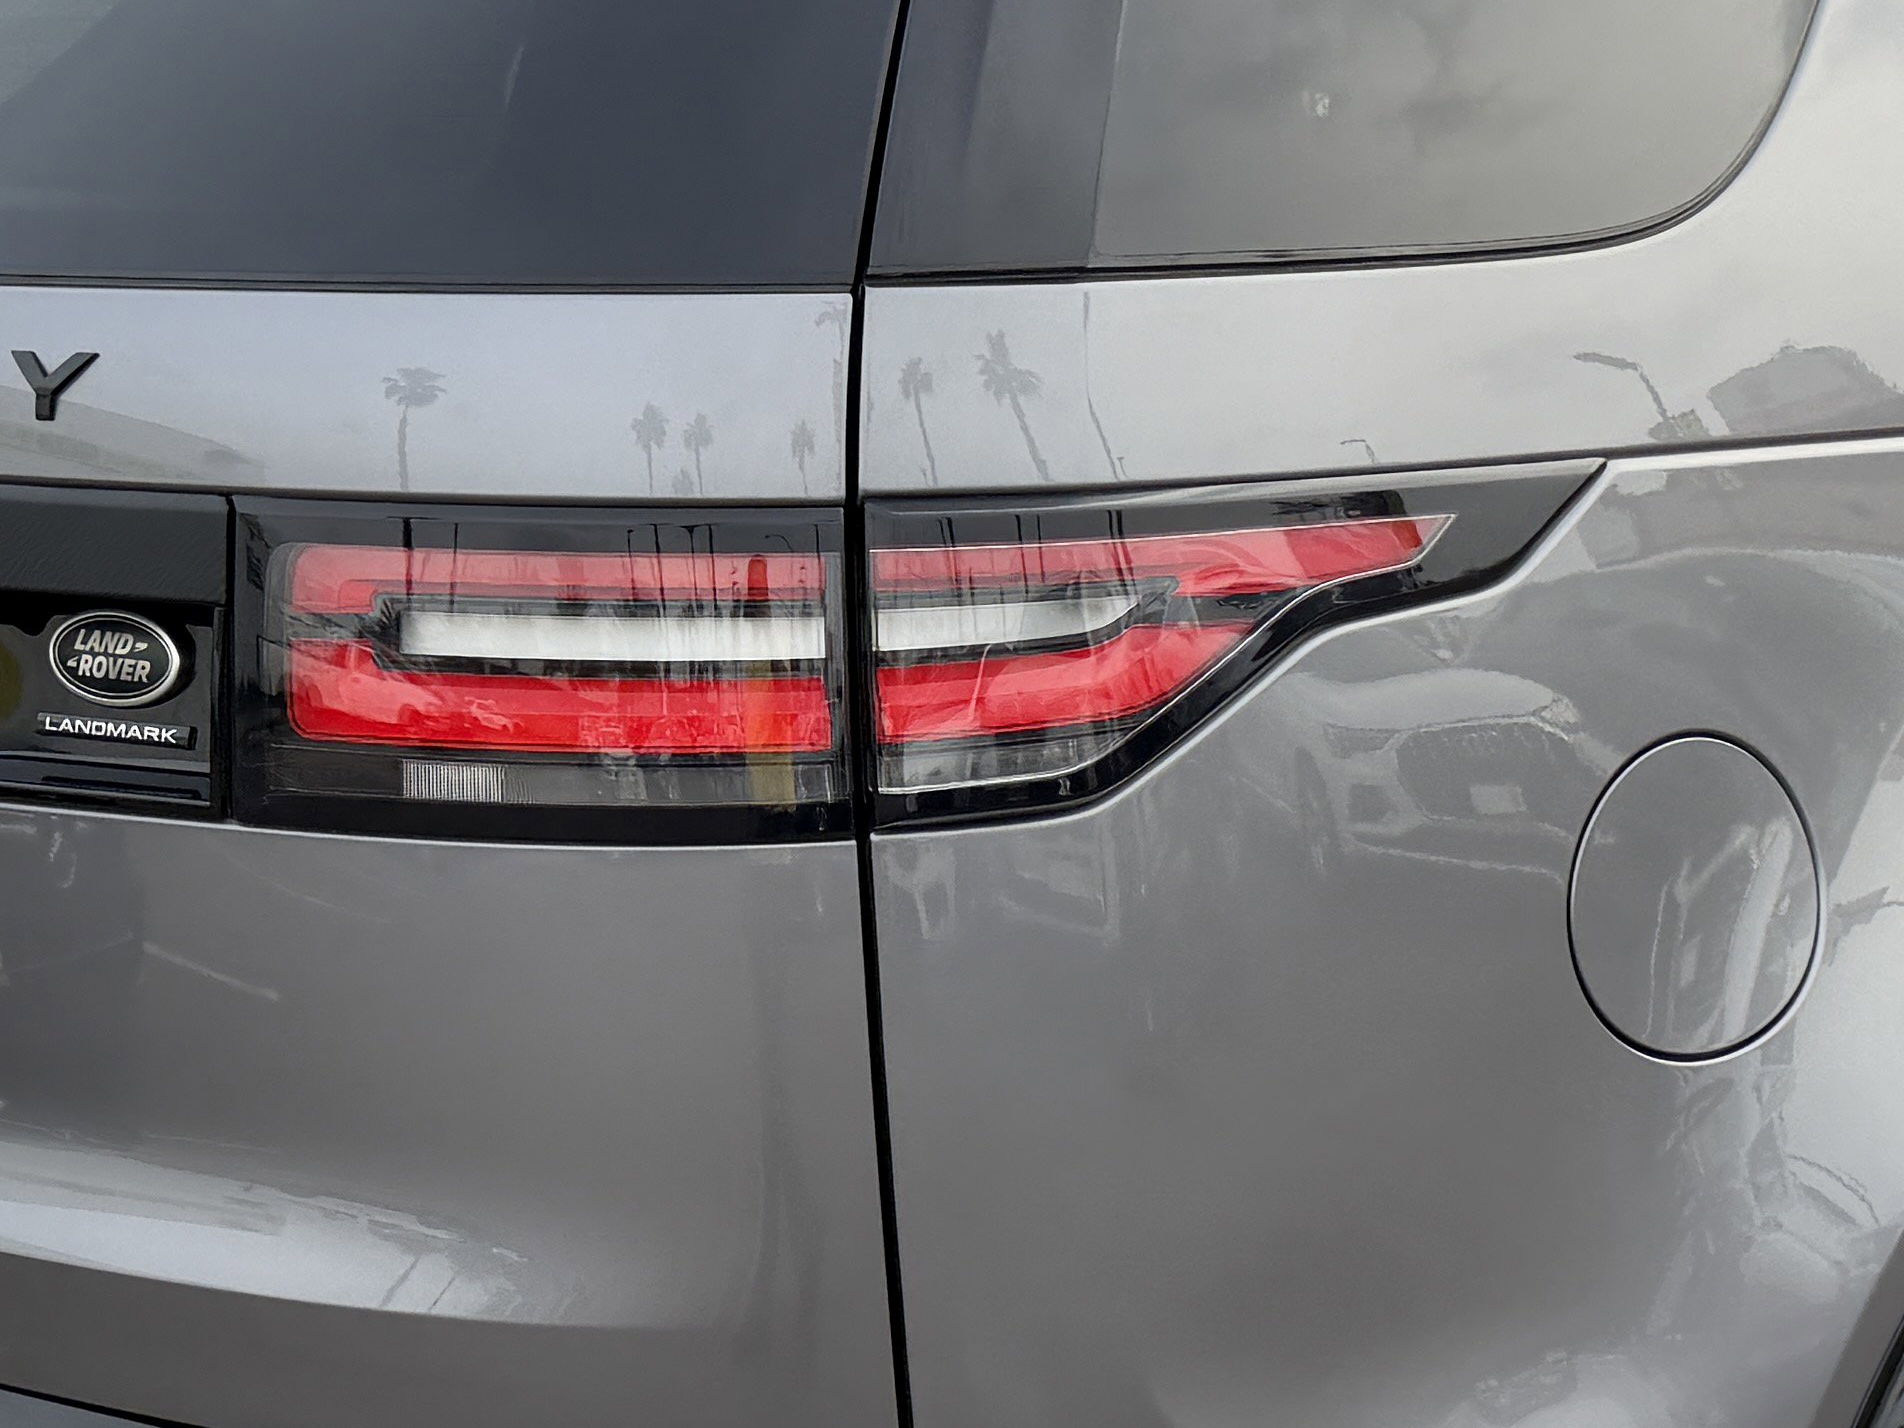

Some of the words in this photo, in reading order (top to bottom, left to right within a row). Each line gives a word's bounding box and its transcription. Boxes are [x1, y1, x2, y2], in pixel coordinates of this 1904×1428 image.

[74, 628, 135, 655] LAND
[77, 654, 151, 683] ROVER
[45, 716, 178, 744] LANDMARK
